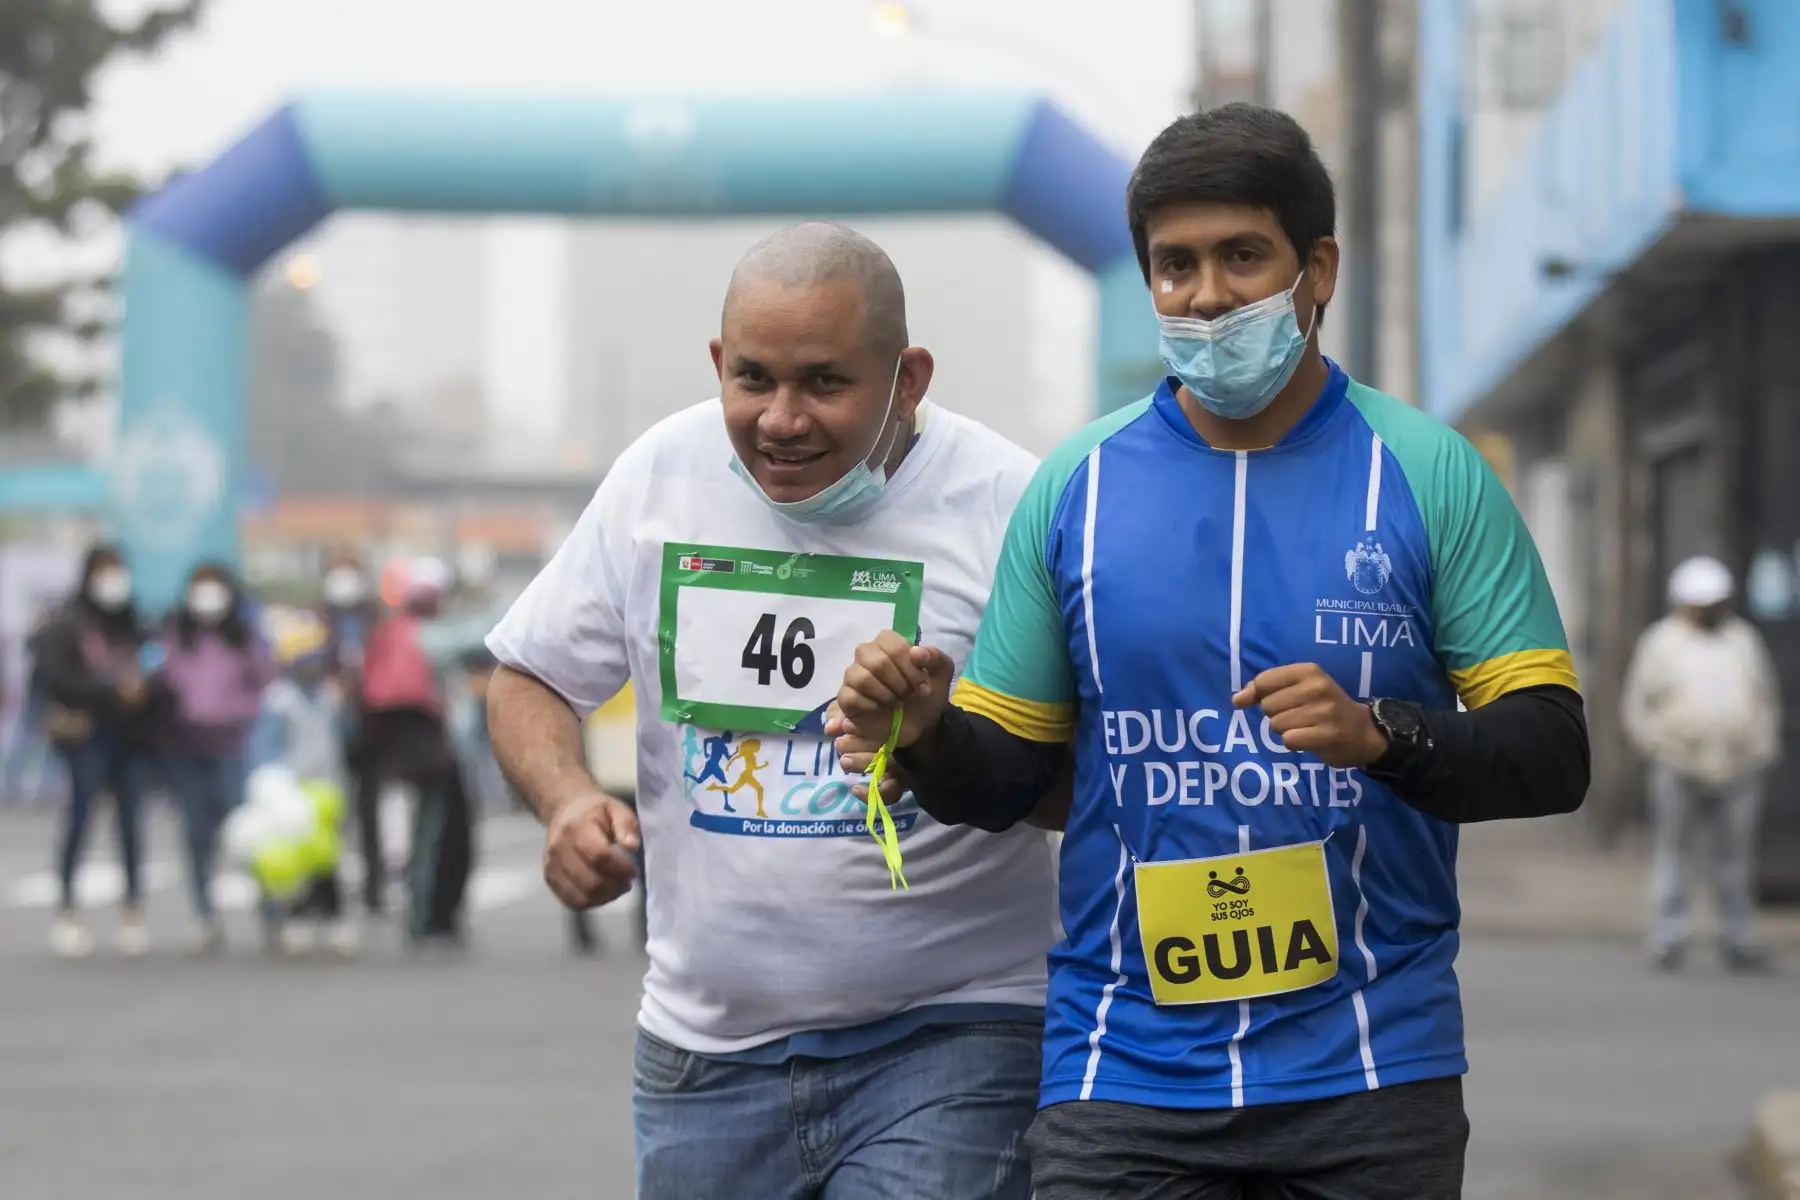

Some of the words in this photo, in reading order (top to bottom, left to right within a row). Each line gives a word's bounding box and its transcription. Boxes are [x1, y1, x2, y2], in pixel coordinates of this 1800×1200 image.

[873, 572, 896, 582] LIMA
[1315, 615, 1415, 648] LIMA
[741, 613, 816, 689] 46
[1102, 708, 1304, 755] EDUCAC
[1109, 762, 1128, 807] Y
[1143, 760, 1363, 808] DEPORTES
[742, 820, 761, 833] Por
[764, 821, 775, 834] la
[777, 821, 835, 835] donación
[837, 821, 856, 834] de
[1211, 911, 1228, 921] SUS
[1229, 907, 1255, 920] OJOS
[1212, 901, 1228, 912] YO
[1229, 899, 1249, 910] SOY
[1154, 919, 1333, 985] GUIA
